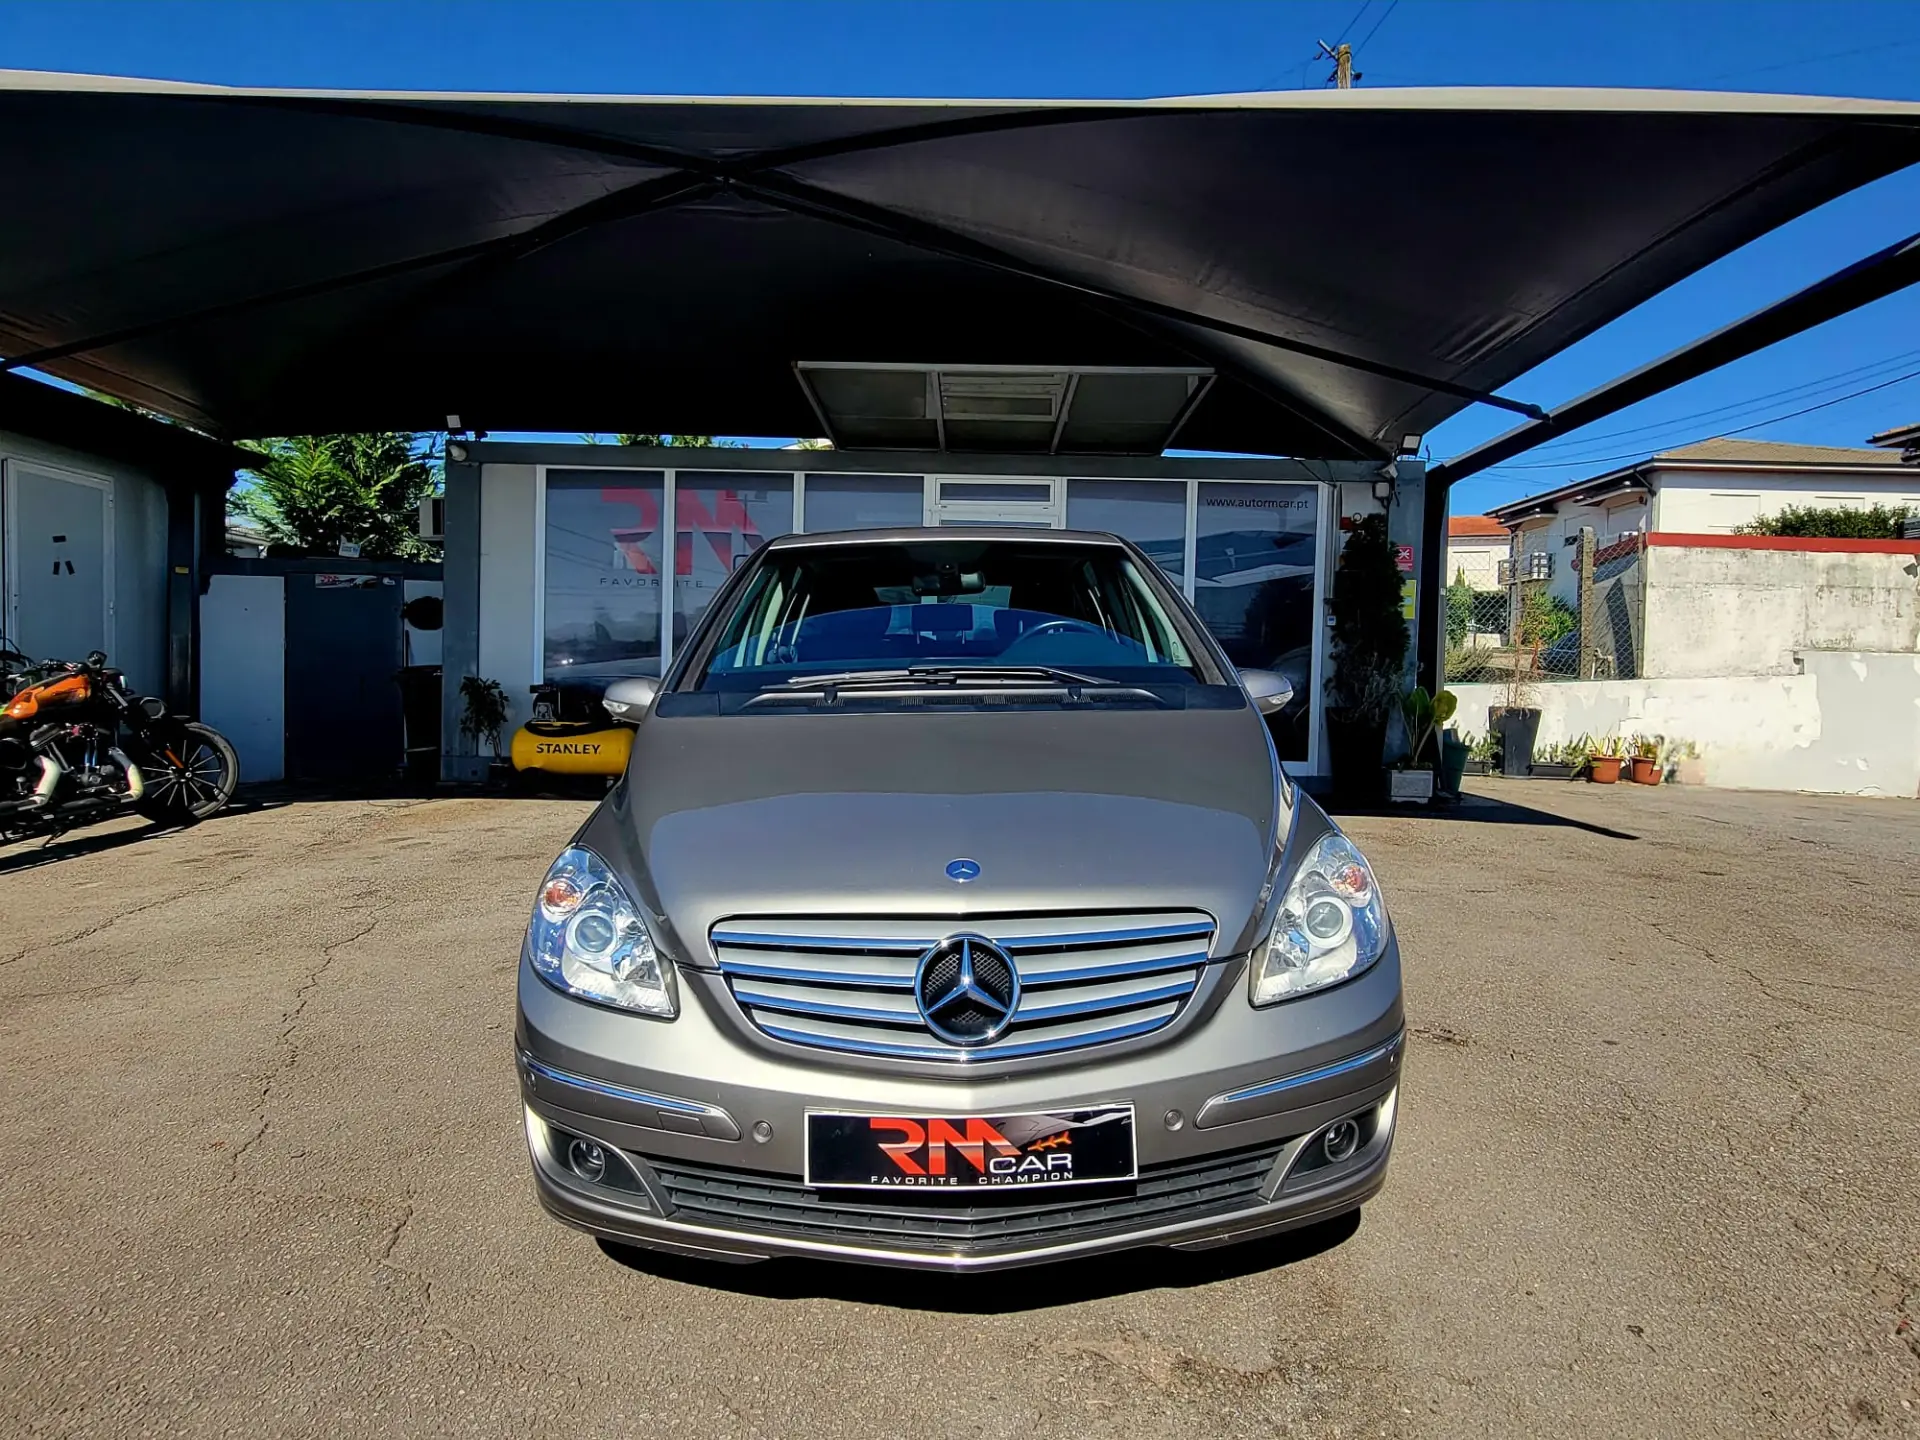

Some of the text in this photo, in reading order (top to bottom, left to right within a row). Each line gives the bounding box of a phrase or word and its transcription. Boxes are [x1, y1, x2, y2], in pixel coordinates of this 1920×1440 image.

[1206, 498, 1309, 510] www.autormcar.pt
[600, 577, 704, 588] FAVORITE
[536, 743, 601, 755] STANLEY
[869, 1117, 1022, 1175] RM
[989, 1153, 1073, 1175] CAR
[870, 1171, 1074, 1186] FAVORITE CHAMPION
